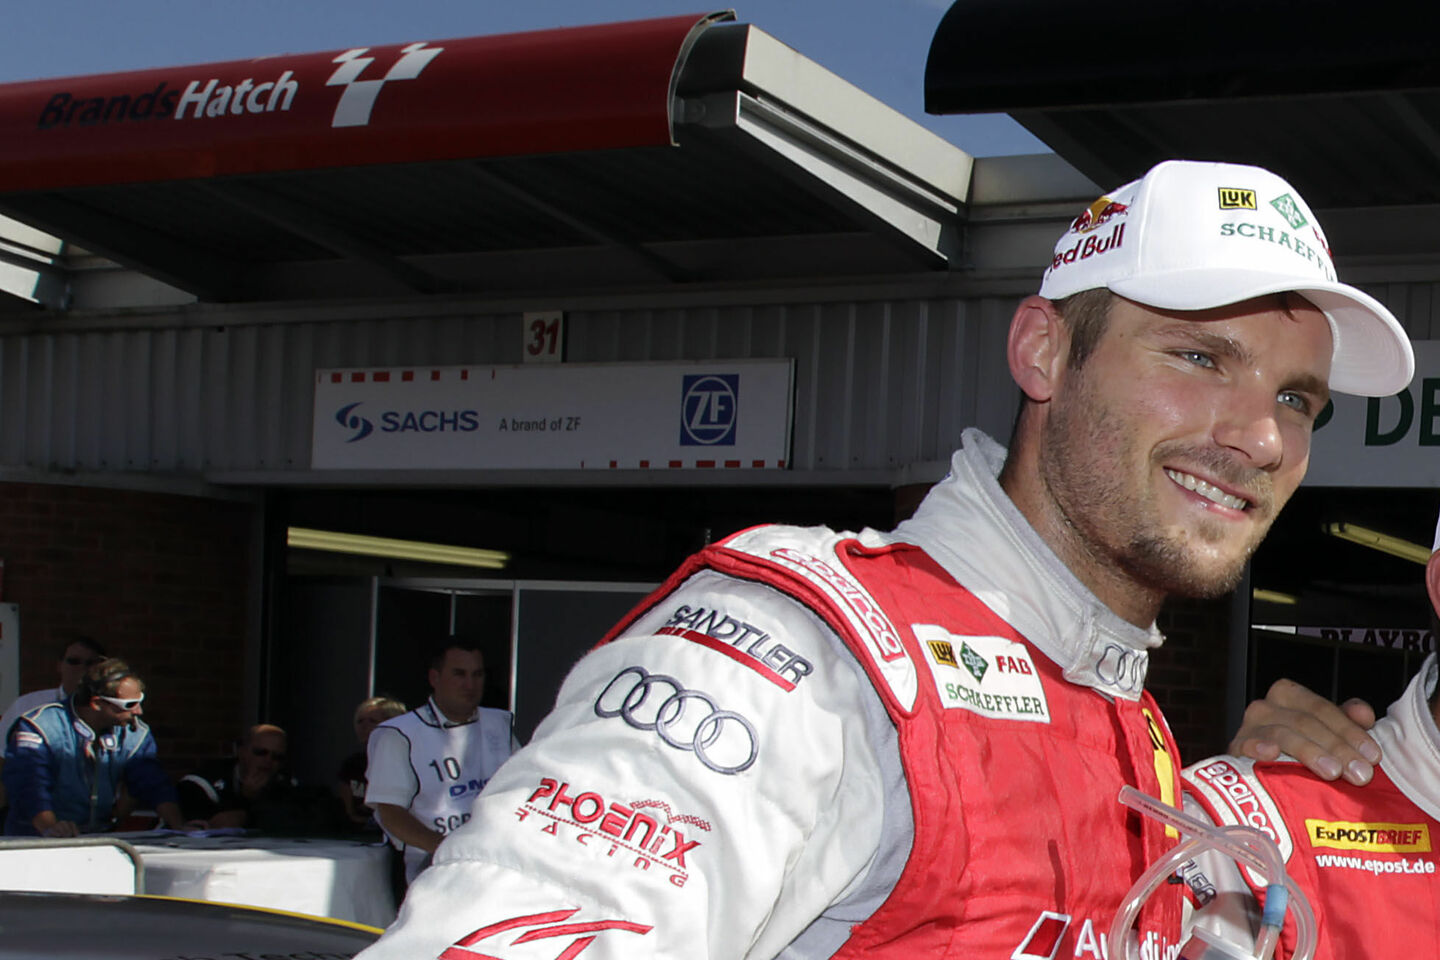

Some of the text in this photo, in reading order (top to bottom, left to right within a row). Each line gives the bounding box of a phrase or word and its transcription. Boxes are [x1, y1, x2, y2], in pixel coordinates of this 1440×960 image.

[1081, 222, 1125, 259] Bull
[527, 318, 559, 356] 31
[380, 410, 582, 432] SACHS A brand of ZF
[688, 391, 728, 427] ZF
[666, 605, 814, 684] SANDTLER
[945, 682, 1045, 716] SCHAEFFLER
[428, 757, 461, 783] 10
[1315, 855, 1436, 876] www.epost.de
